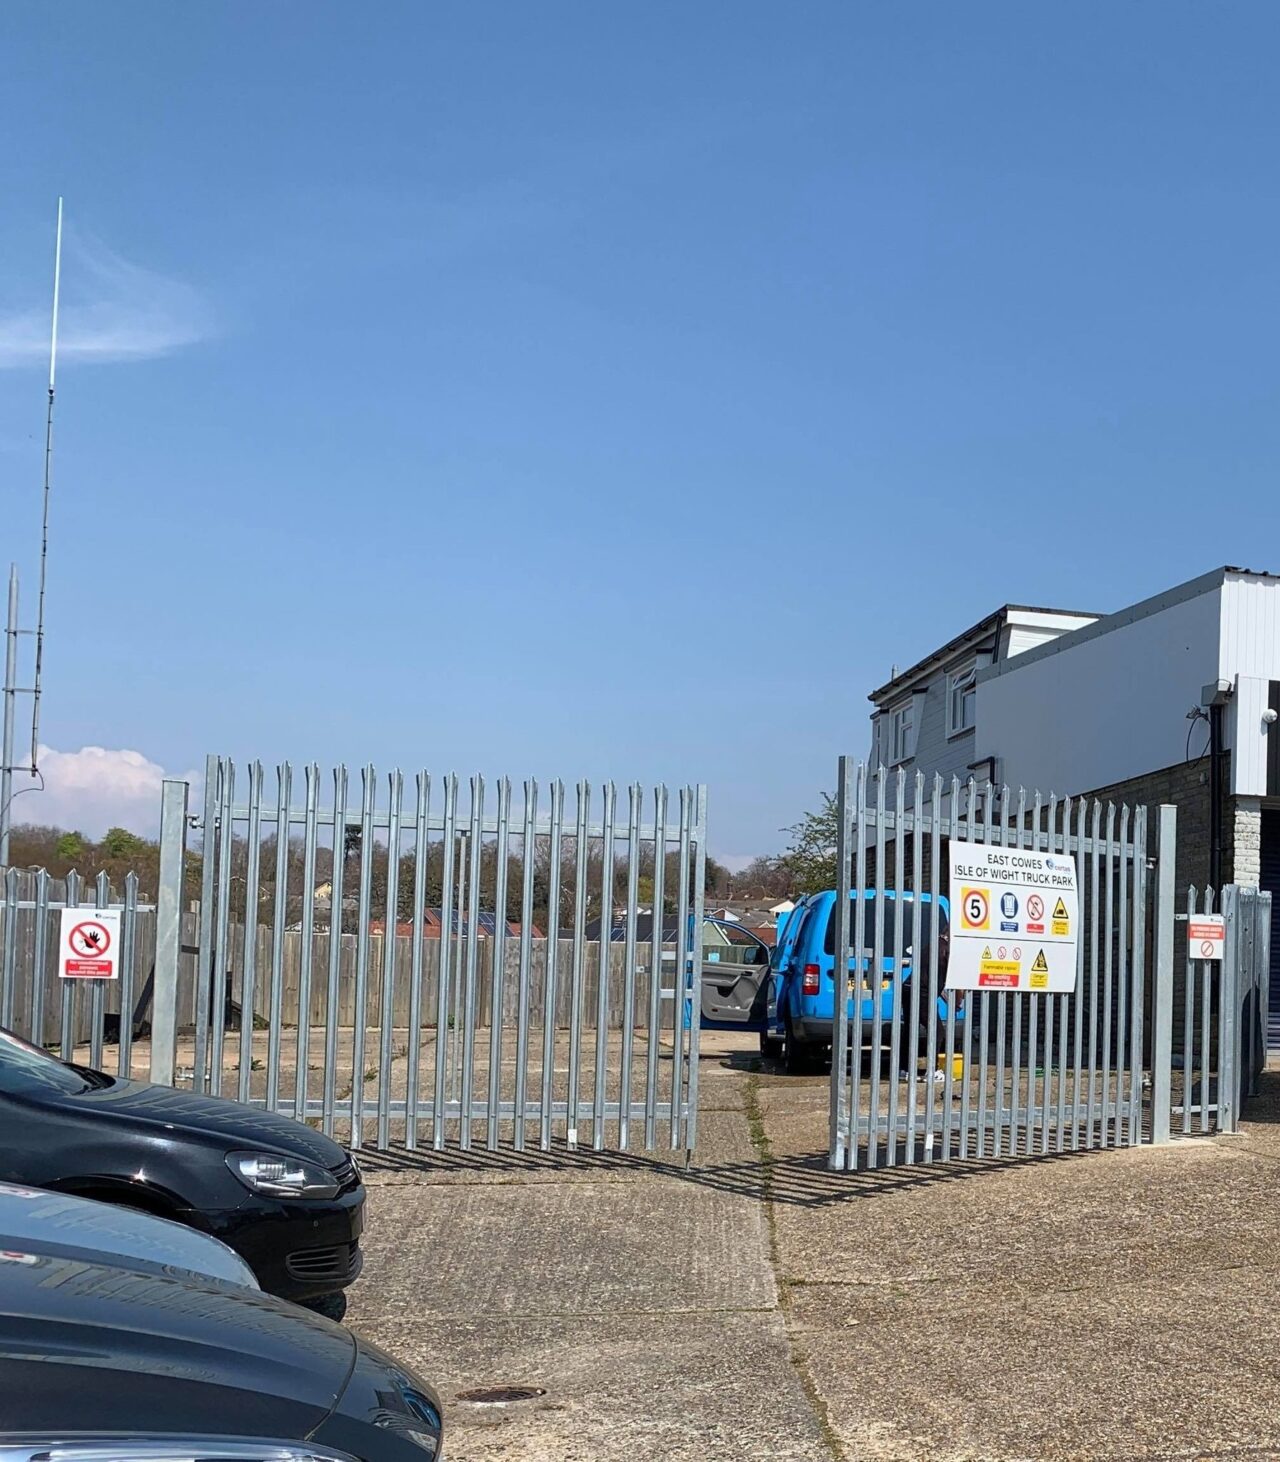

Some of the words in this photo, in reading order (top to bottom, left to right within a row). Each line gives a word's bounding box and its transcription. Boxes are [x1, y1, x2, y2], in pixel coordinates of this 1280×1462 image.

[987, 854, 1009, 866] EAST
[1011, 857, 1042, 869] COWES
[954, 865, 973, 876] ISLE
[975, 867, 988, 878] OF
[990, 869, 1019, 881] WIGHT
[1022, 872, 1050, 884] TRUCK
[1052, 875, 1073, 886] PARK
[970, 899, 981, 919] 5
